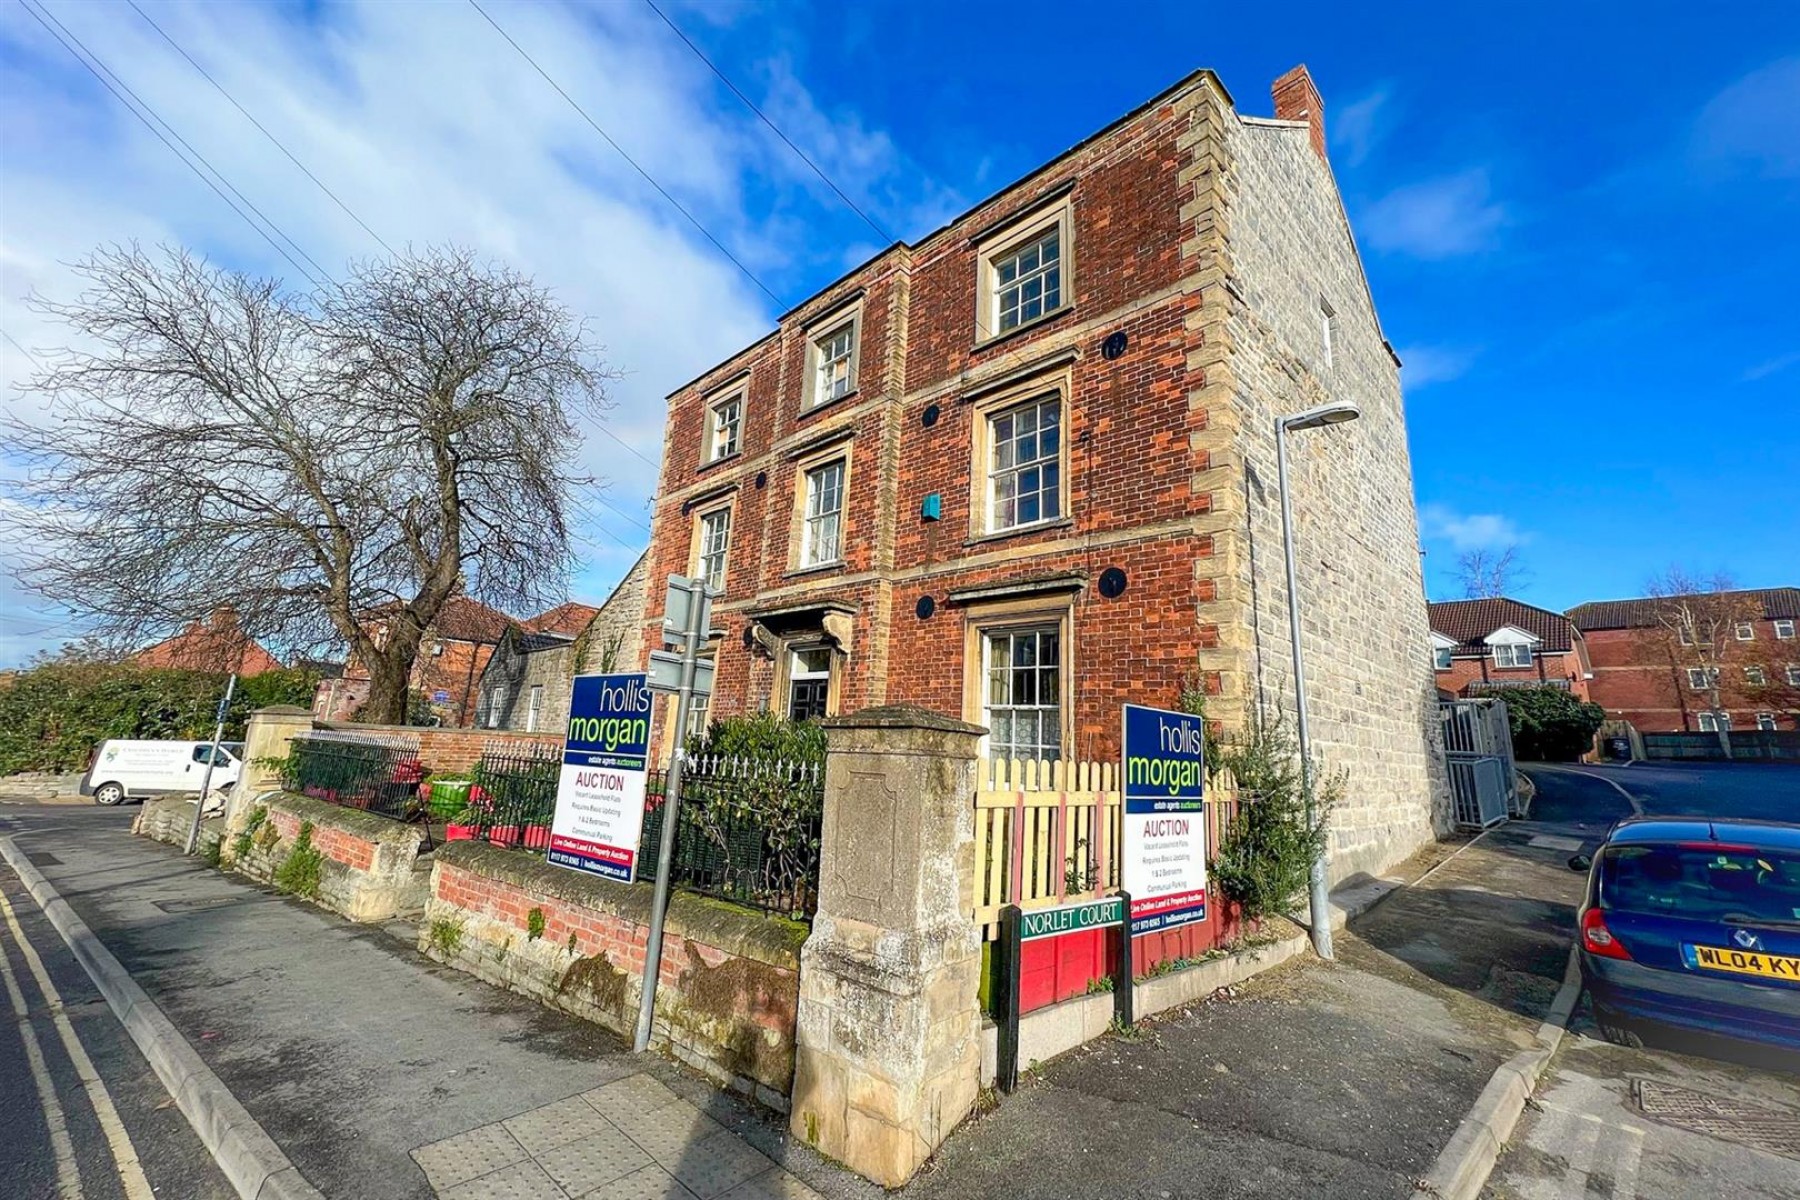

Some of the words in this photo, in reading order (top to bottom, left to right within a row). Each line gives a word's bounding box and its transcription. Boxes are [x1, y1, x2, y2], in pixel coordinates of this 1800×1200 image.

[600, 679, 650, 712] hollis
[568, 717, 647, 752] morgan
[1159, 716, 1201, 755] hollis
[575, 771, 625, 791] AUCTION
[1128, 756, 1201, 795] morgan
[1143, 819, 1190, 838] AUCTION
[577, 842, 588, 851] Land
[591, 846, 610, 858] Property
[610, 850, 629, 860] Auction
[1187, 894, 1203, 902] Auction
[1025, 909, 1075, 936] NORLET
[1080, 903, 1118, 926] COURT
[1698, 947, 1763, 971] WL04
[1770, 957, 1800, 977] KY
